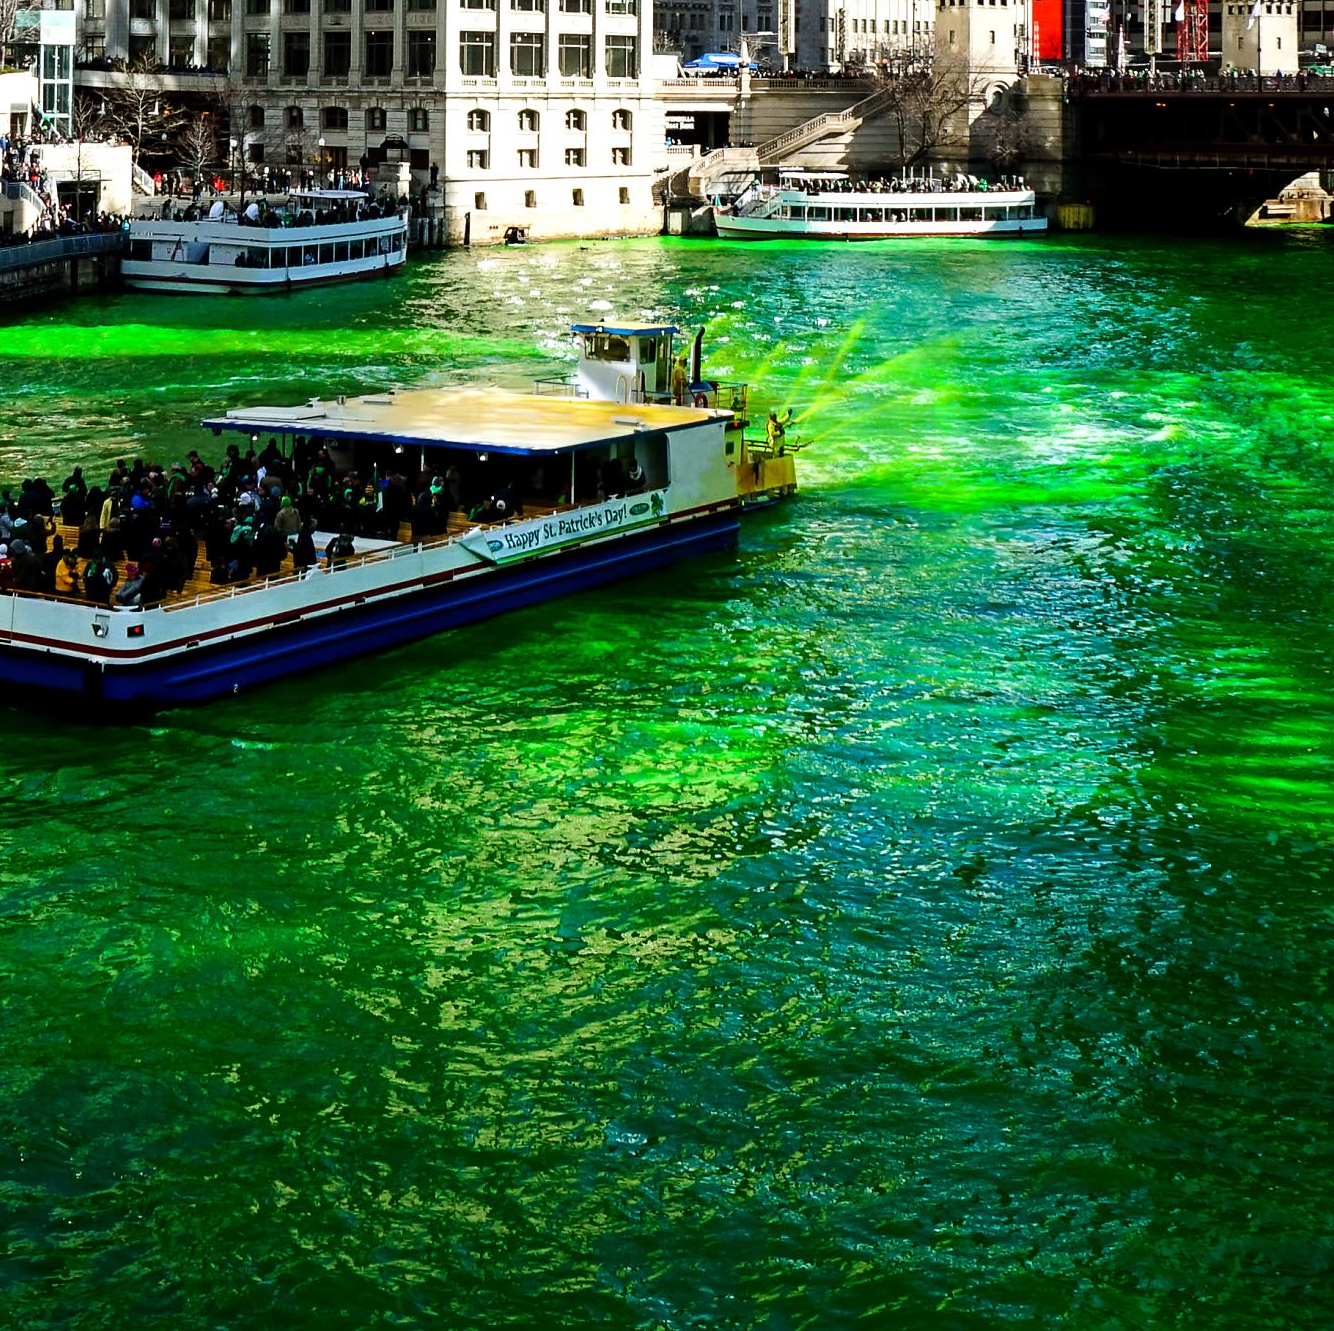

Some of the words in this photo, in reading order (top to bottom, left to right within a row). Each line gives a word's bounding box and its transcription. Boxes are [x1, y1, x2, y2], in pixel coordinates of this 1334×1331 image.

[504, 529, 540, 549] Happy
[543, 523, 557, 539] St.
[558, 511, 603, 535] Patrick's
[604, 504, 627, 524] Day!
